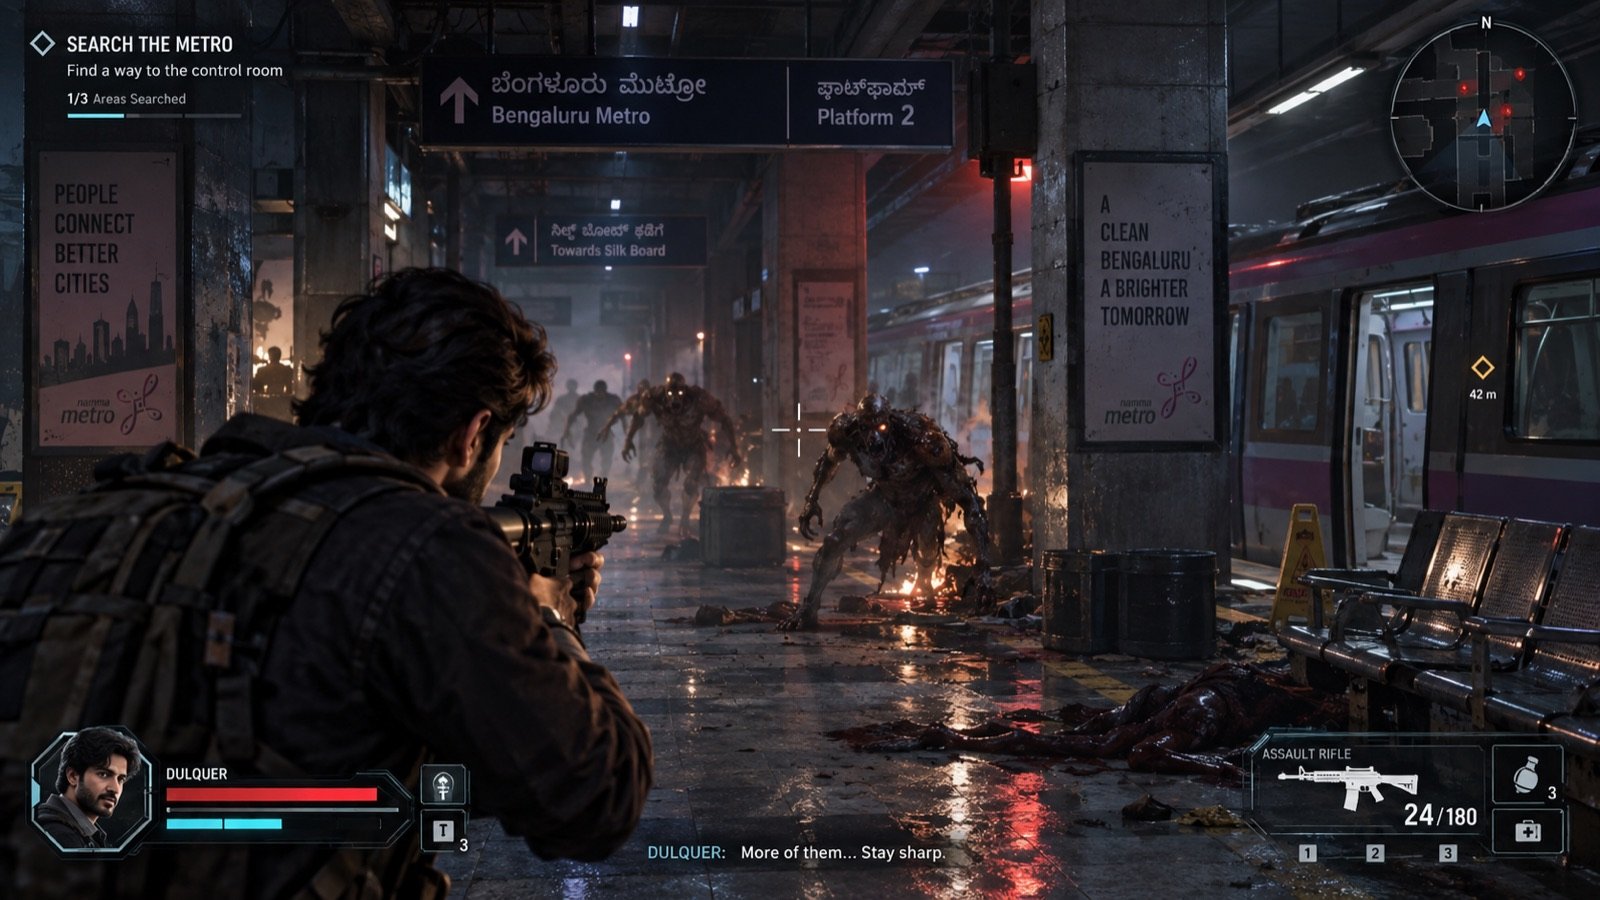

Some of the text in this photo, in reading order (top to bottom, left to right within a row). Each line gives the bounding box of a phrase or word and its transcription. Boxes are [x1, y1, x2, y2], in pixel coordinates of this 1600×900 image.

[491, 70, 607, 95] ಬೆಂಗಳೂರು
[491, 105, 651, 127] Bengaluru Metro
[817, 104, 915, 125] Platform 2
[54, 183, 118, 205] PEOPLE
[1100, 194, 1111, 214] A
[54, 213, 135, 235] CONNECT
[1101, 222, 1149, 242] CLEAN
[54, 243, 119, 264] BETTER
[551, 244, 666, 257] Towards Silk Board
[1101, 251, 1191, 270] BENGALURU
[54, 273, 110, 294] CITIES
[1100, 279, 1188, 298] A BRIGHTER
[1101, 306, 1190, 326] TOMORROW
[60, 407, 116, 424] metro
[1104, 407, 1156, 425] metro
